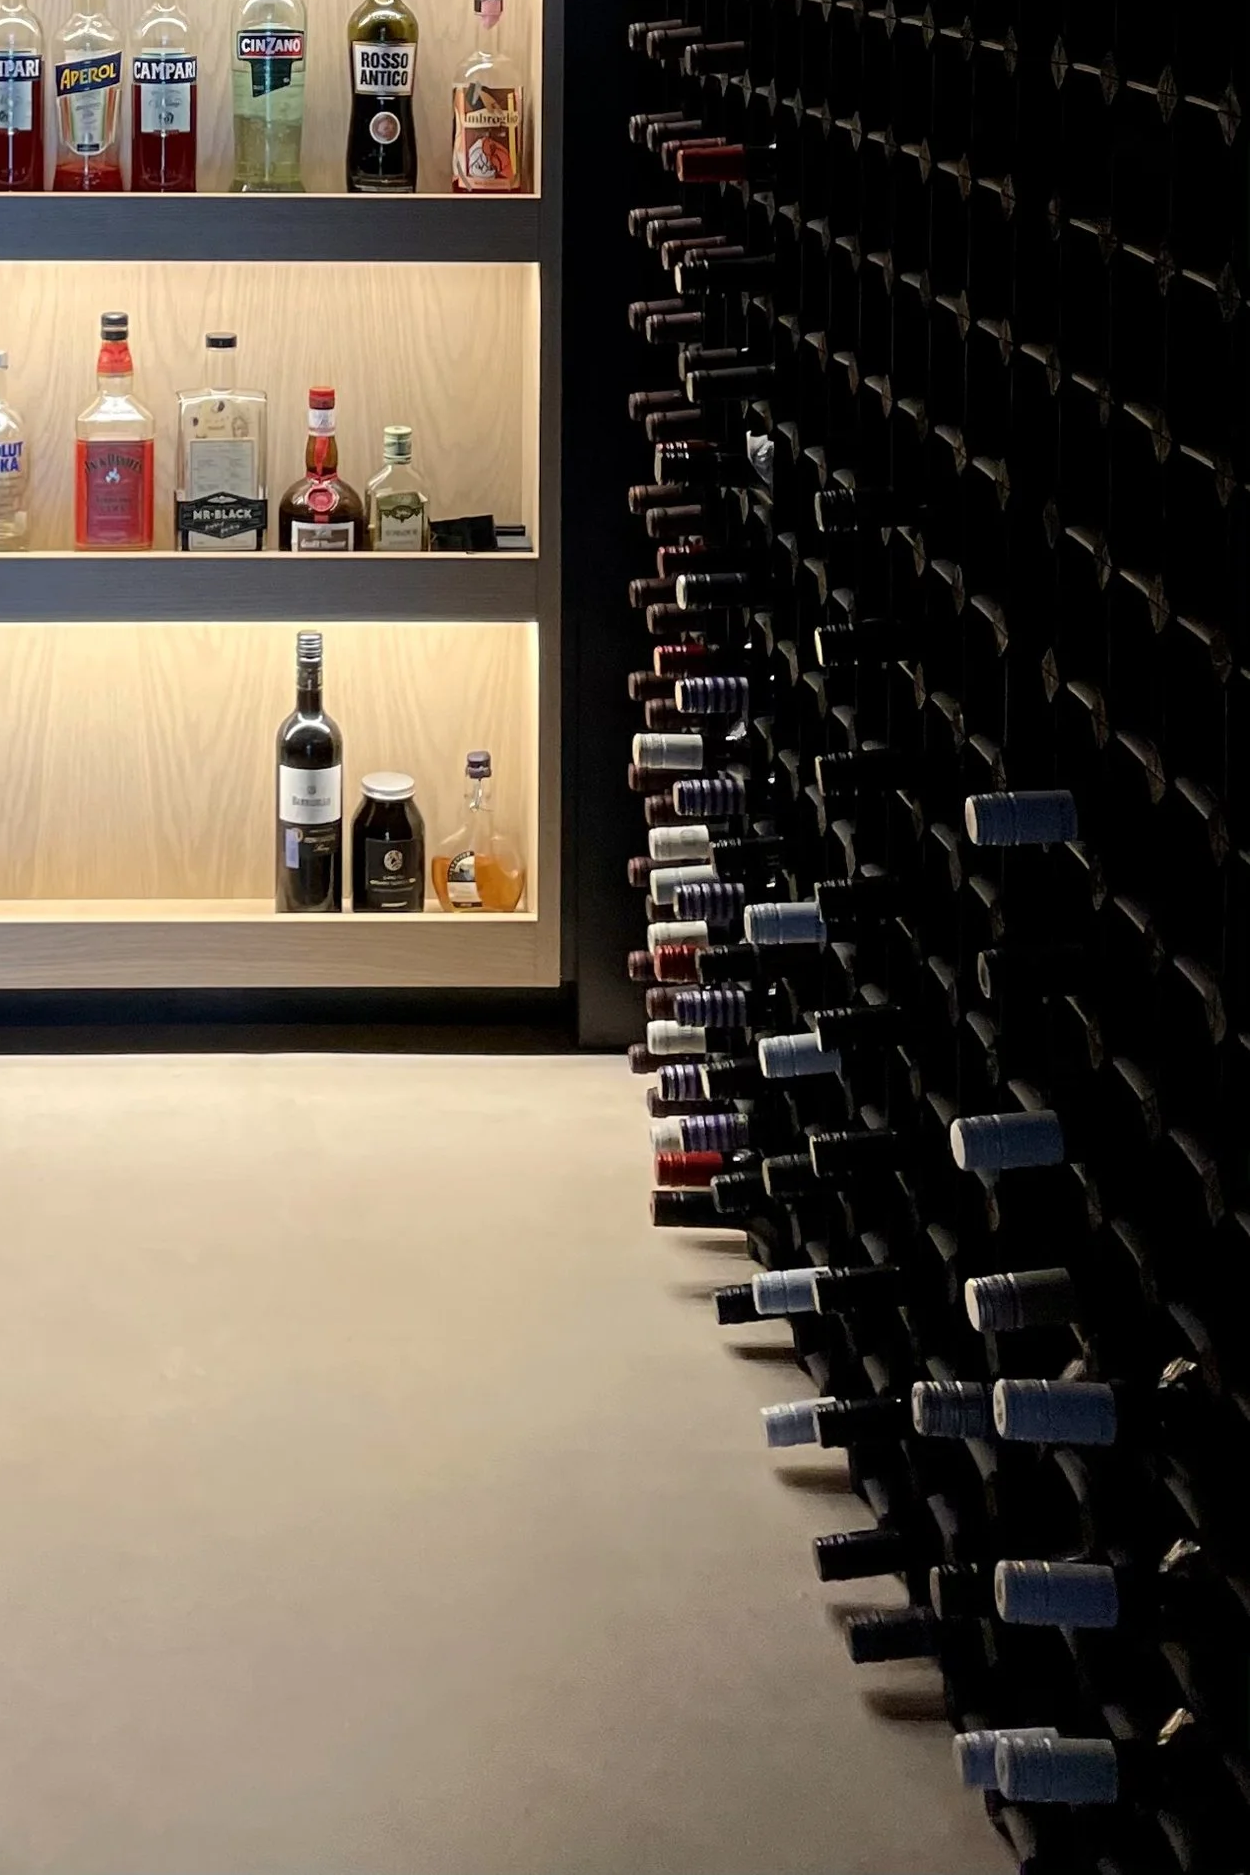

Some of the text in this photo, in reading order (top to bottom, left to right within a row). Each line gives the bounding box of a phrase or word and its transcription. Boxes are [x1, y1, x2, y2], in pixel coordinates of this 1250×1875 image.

[240, 37, 301, 55] CINZANO
[133, 60, 196, 79] CAMPARI
[360, 52, 409, 69] ROSSO
[60, 61, 117, 91] APEROL
[360, 69, 409, 87] ANTICO
[214, 509, 252, 520] BLACK
